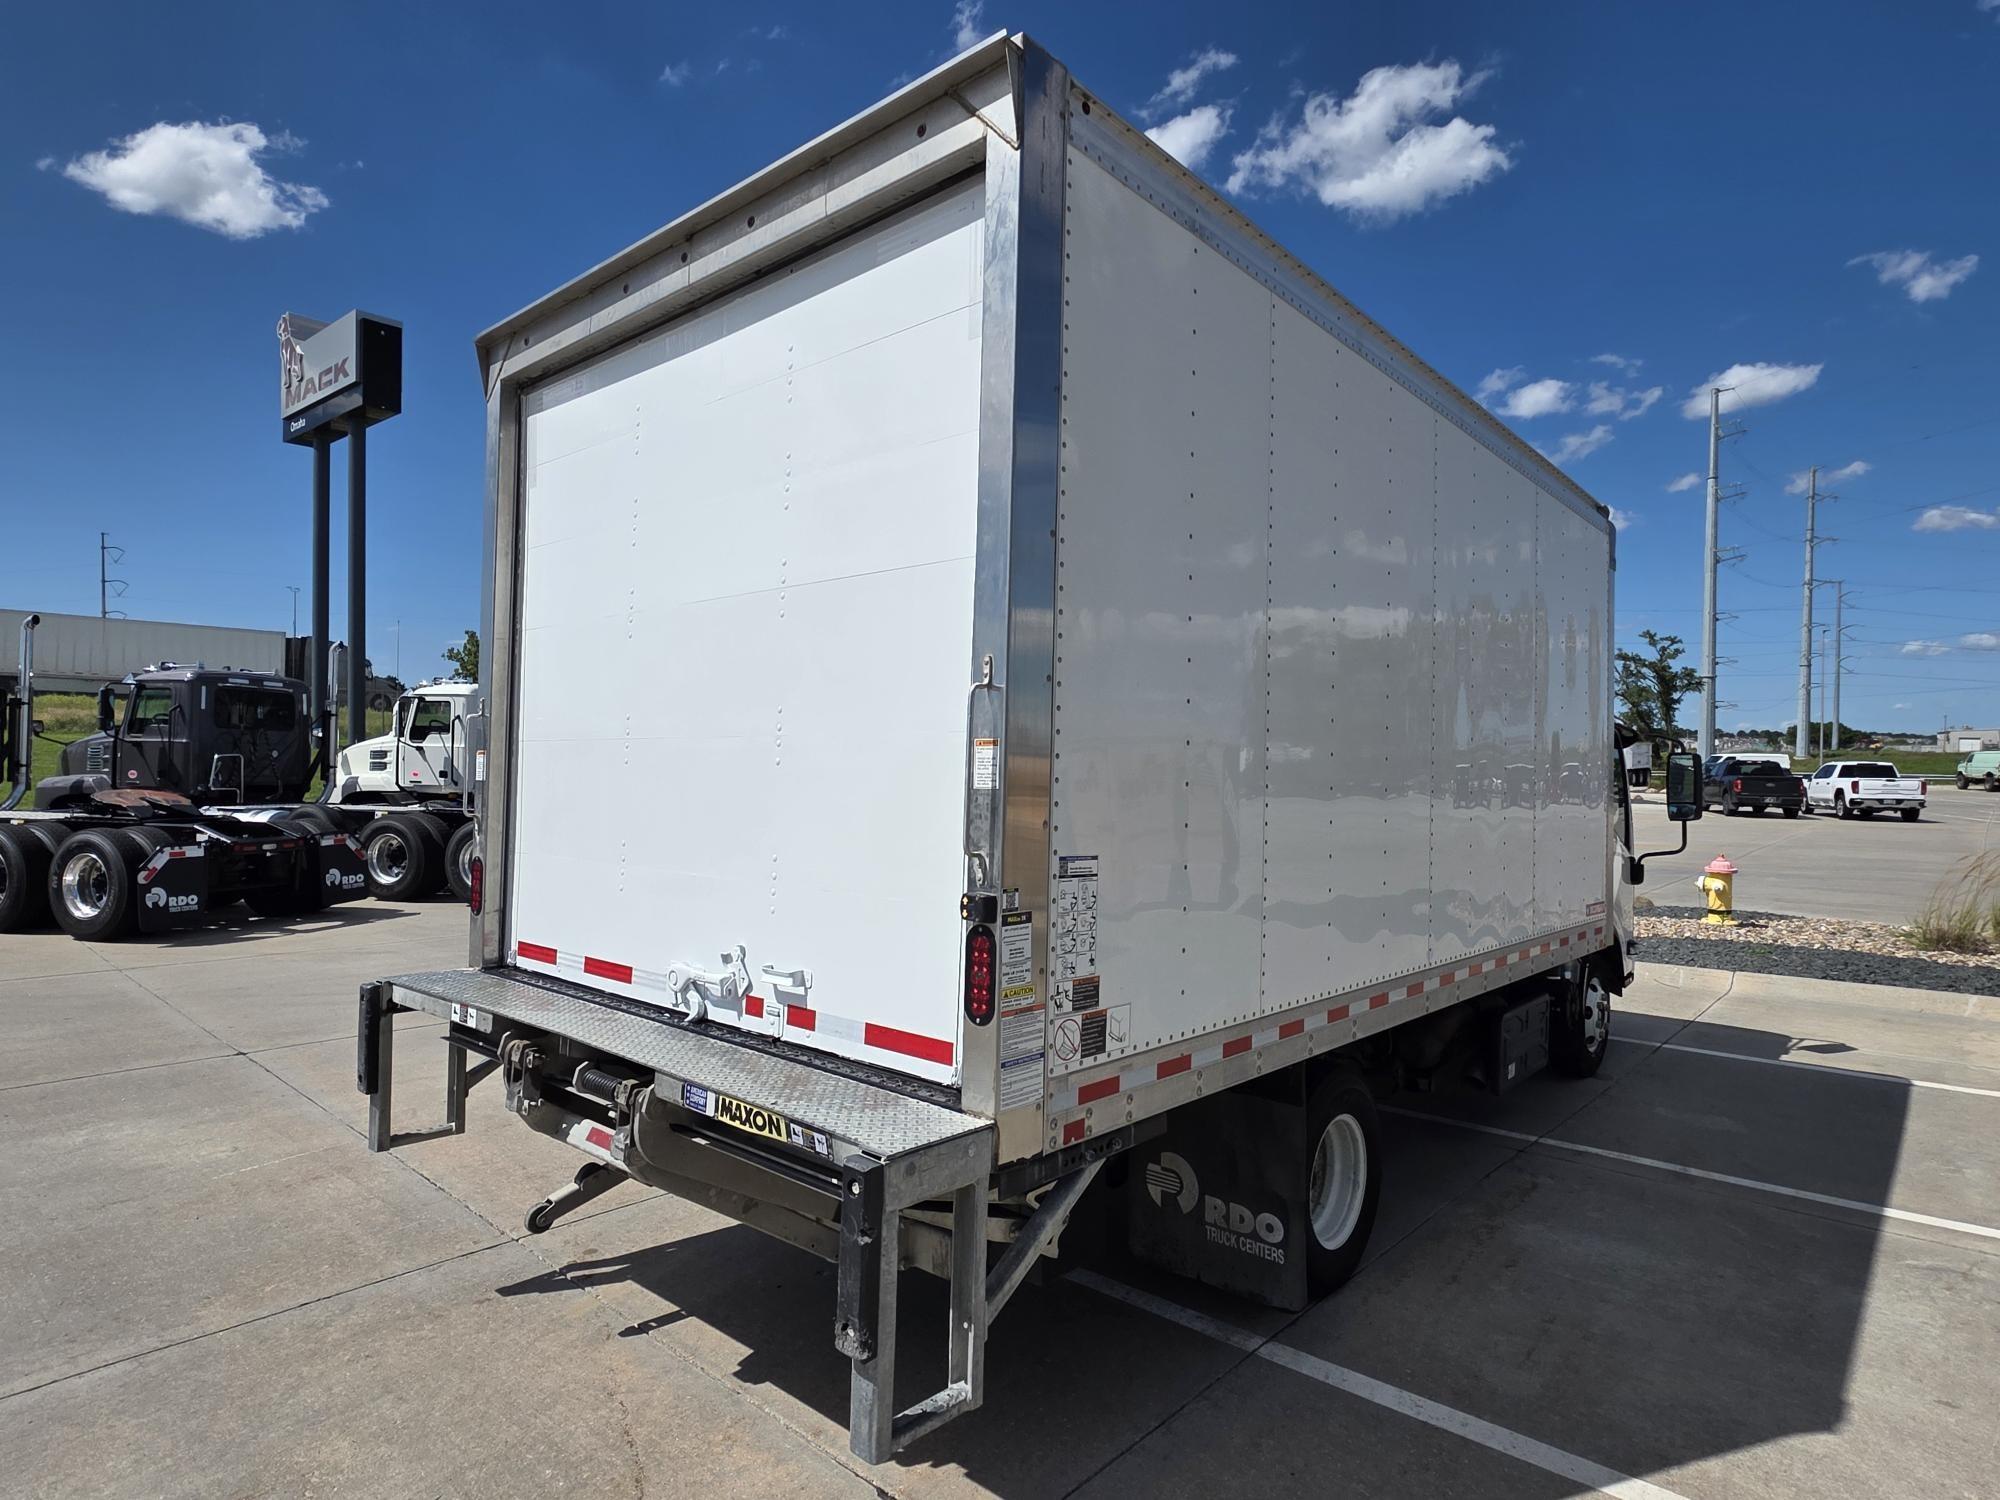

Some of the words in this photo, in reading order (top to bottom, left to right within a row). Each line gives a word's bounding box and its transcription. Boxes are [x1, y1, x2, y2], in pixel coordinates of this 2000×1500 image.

[285, 356, 350, 409] MACK
[291, 417, 305, 432] Omaha
[342, 873, 364, 884] RDO
[168, 894, 198, 906] RDO
[1009, 986, 1034, 997] CAUTION
[690, 1086, 707, 1098] AMERICAN
[719, 1097, 782, 1138] MAXON
[1204, 1194, 1285, 1244] RDO
[1205, 1225, 1238, 1249] TRUCK
[1239, 1236, 1285, 1265] CENTERS
